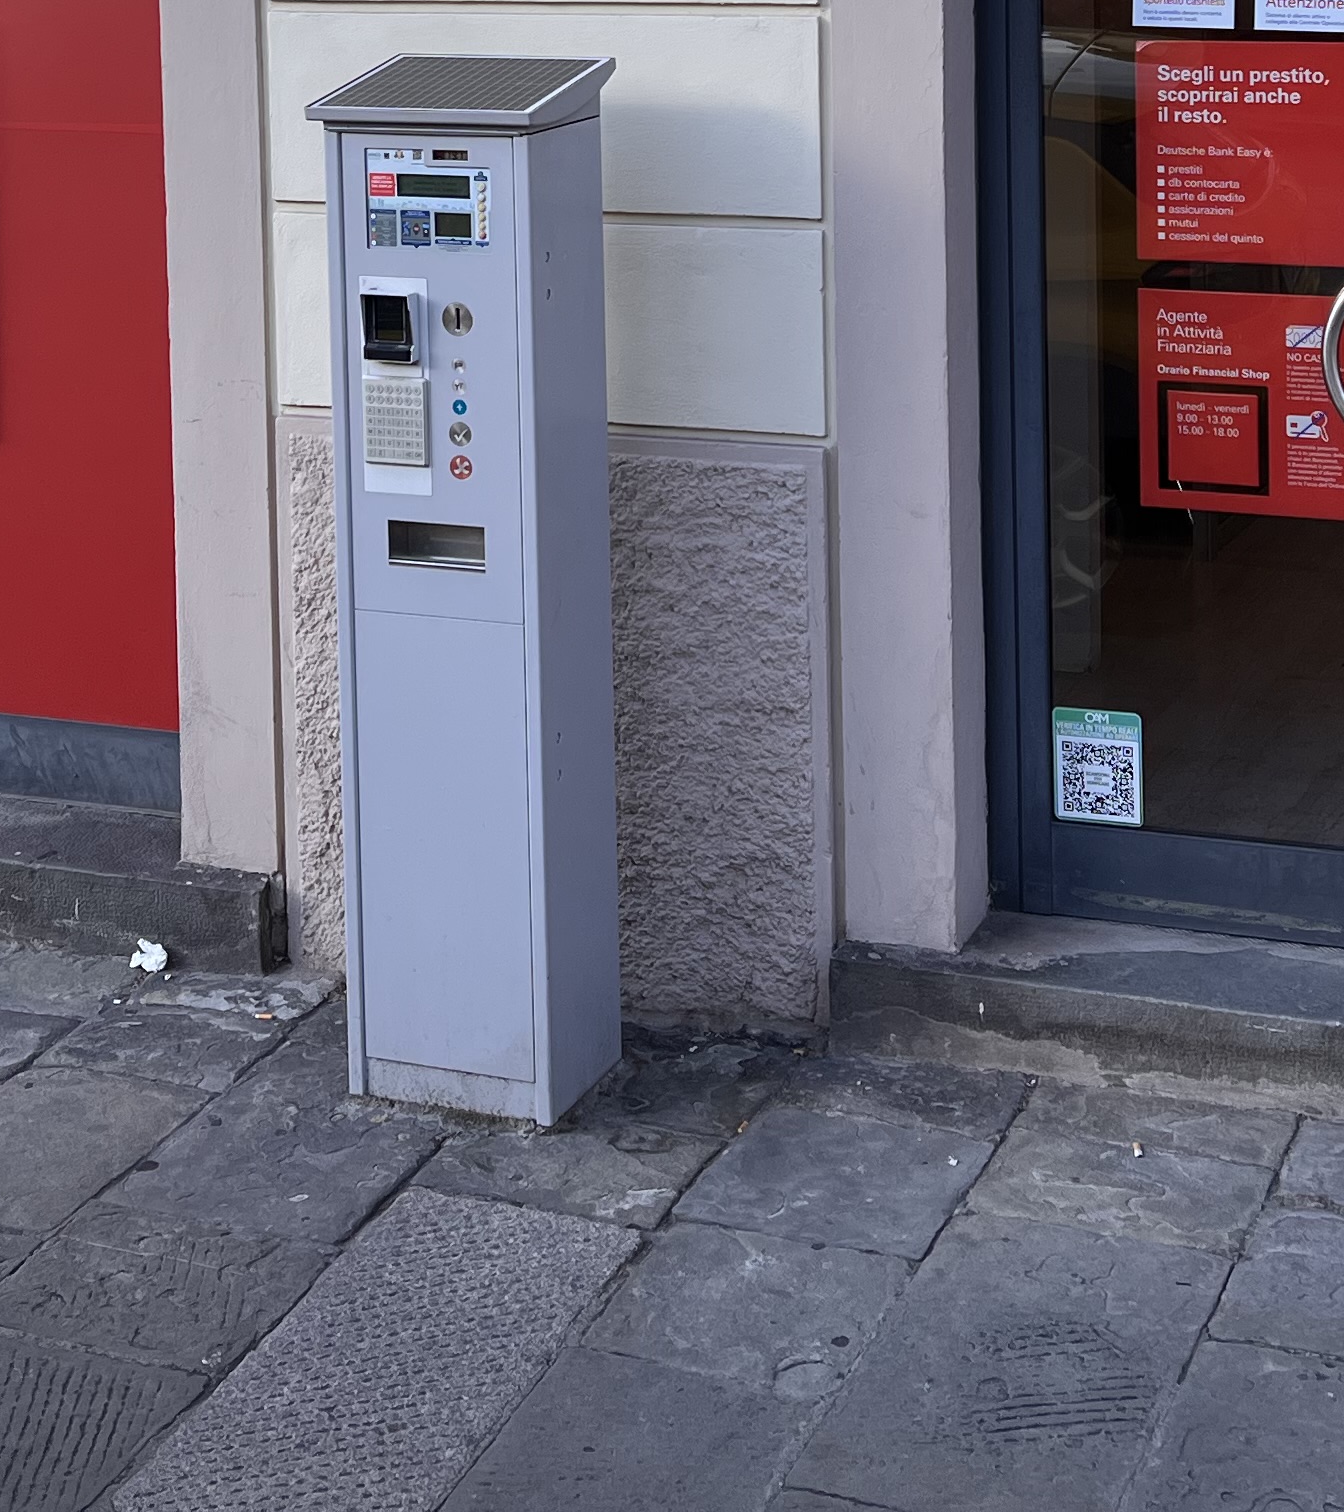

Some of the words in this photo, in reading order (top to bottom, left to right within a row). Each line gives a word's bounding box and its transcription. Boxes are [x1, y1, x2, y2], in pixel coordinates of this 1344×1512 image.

[1157, 65, 1214, 86] Scegli
[1219, 69, 1244, 83] un
[1249, 67, 1330, 86] prestito,
[1157, 86, 1239, 106] scoprirai
[1243, 88, 1302, 105] anche
[1157, 106, 1168, 123] il
[1174, 108, 1228, 124] resto.
[1157, 144, 1206, 157] Deutsche
[1208, 145, 1234, 157] Bank
[1236, 146, 1262, 159] Easy
[1168, 165, 1203, 176] prestiti
[1168, 177, 1182, 188] db
[1184, 178, 1240, 190] contocarta
[1168, 191, 1195, 202] carte
[1197, 191, 1207, 202] di
[1209, 192, 1246, 203] credito
[1168, 205, 1234, 216] assicurazioni
[1168, 218, 1199, 229] mutui
[1168, 231, 1210, 242] cessioni
[1212, 232, 1228, 243] del
[1230, 233, 1264, 245] quinto
[1156, 308, 1208, 325] Agente
[1157, 325, 1170, 337] in
[1173, 324, 1224, 340] Attività
[1157, 339, 1233, 356] Finanziaria
[1286, 352, 1302, 363] NO
[1303, 353, 1322, 363] CAS
[1157, 364, 1191, 376] Orario
[1192, 365, 1239, 379] Financial
[1241, 367, 1270, 382] Shop
[1176, 400, 1206, 412] lunedì
[1214, 402, 1250, 415] venerdì
[1176, 413, 1199, 423] 9.00
[1207, 415, 1234, 426] 13.00
[1177, 425, 1204, 436] 15.00
[1213, 427, 1240, 438] 18.00
[1084, 711, 1108, 725] OAM
